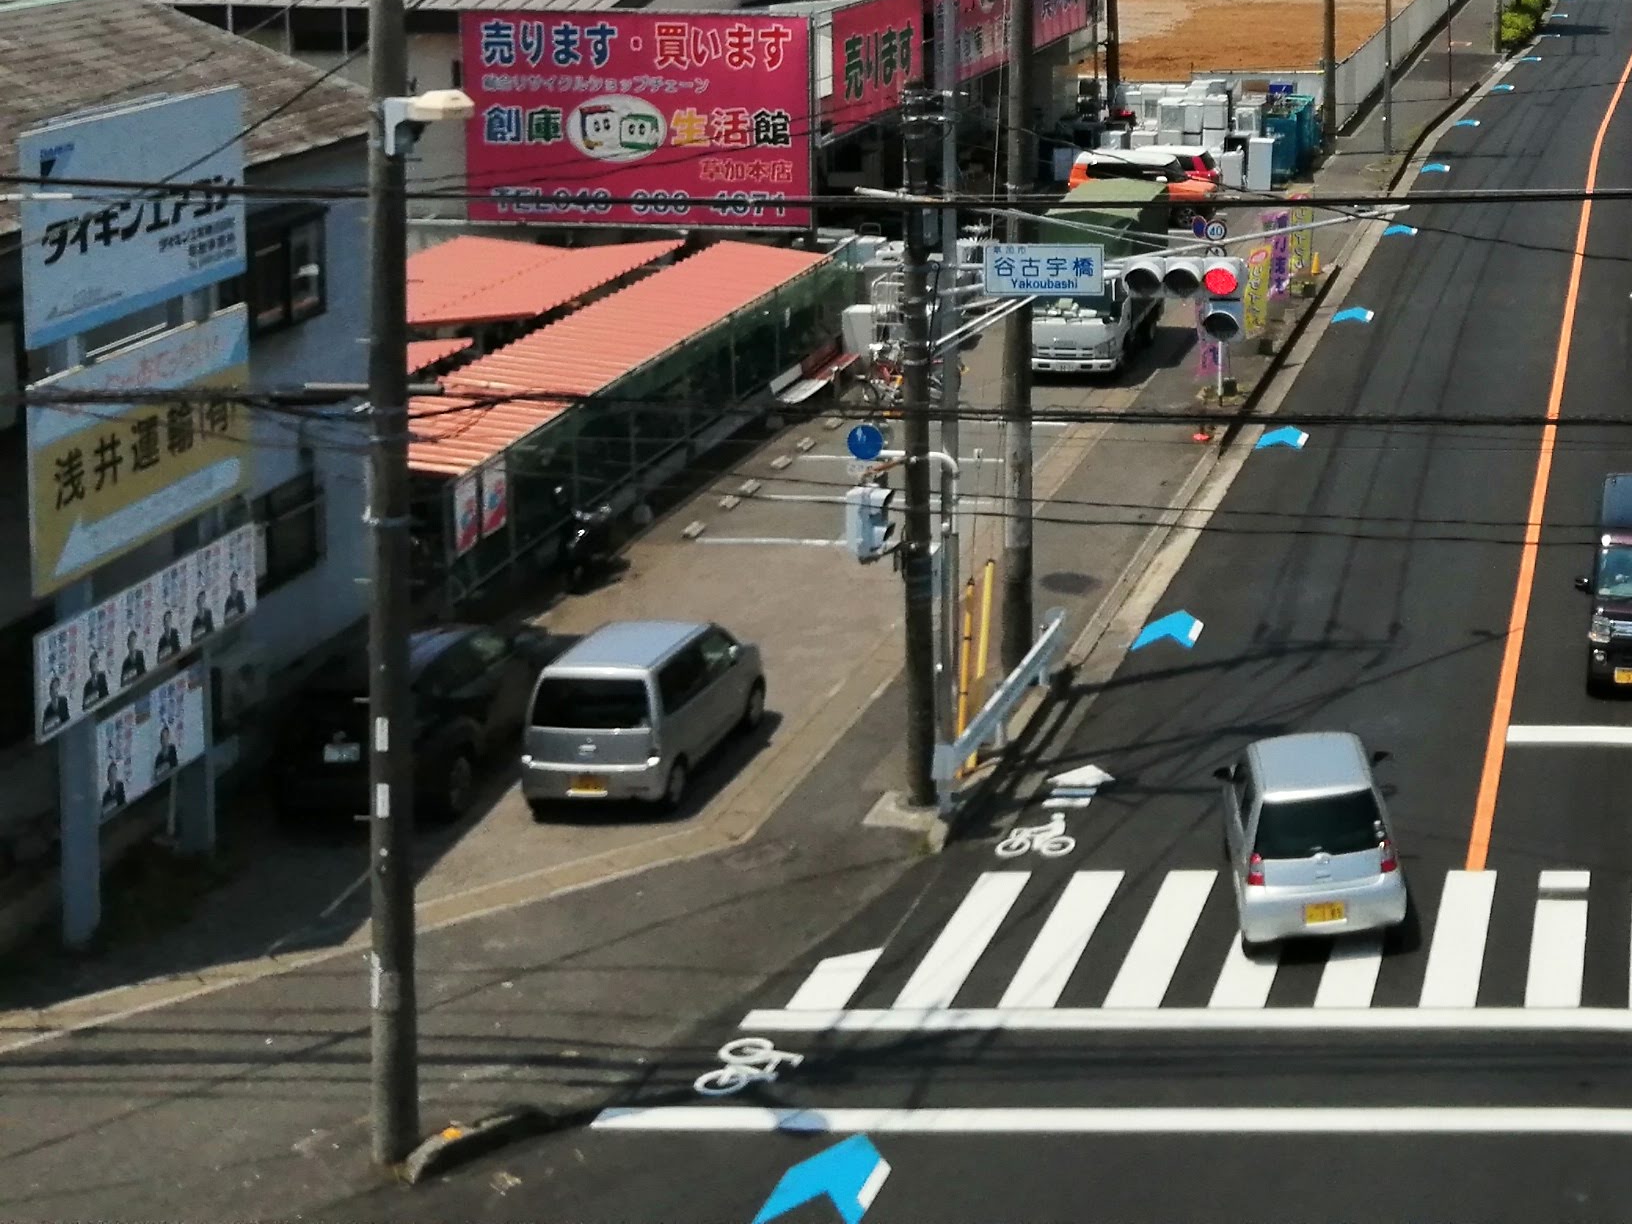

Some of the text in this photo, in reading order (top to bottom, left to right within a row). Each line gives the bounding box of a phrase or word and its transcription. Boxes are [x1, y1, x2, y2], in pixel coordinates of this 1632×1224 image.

[481, 20, 793, 72] 売ります・買います
[844, 18, 914, 102] 売ります
[483, 104, 792, 149] 創庫 生活館
[700, 157, 794, 184] 草加本店
[41, 174, 237, 266] ダイキンエアコン
[1209, 225, 1224, 237] 40
[994, 256, 1095, 277] 谷古宇橋
[1011, 278, 1079, 290] Yakoubashi
